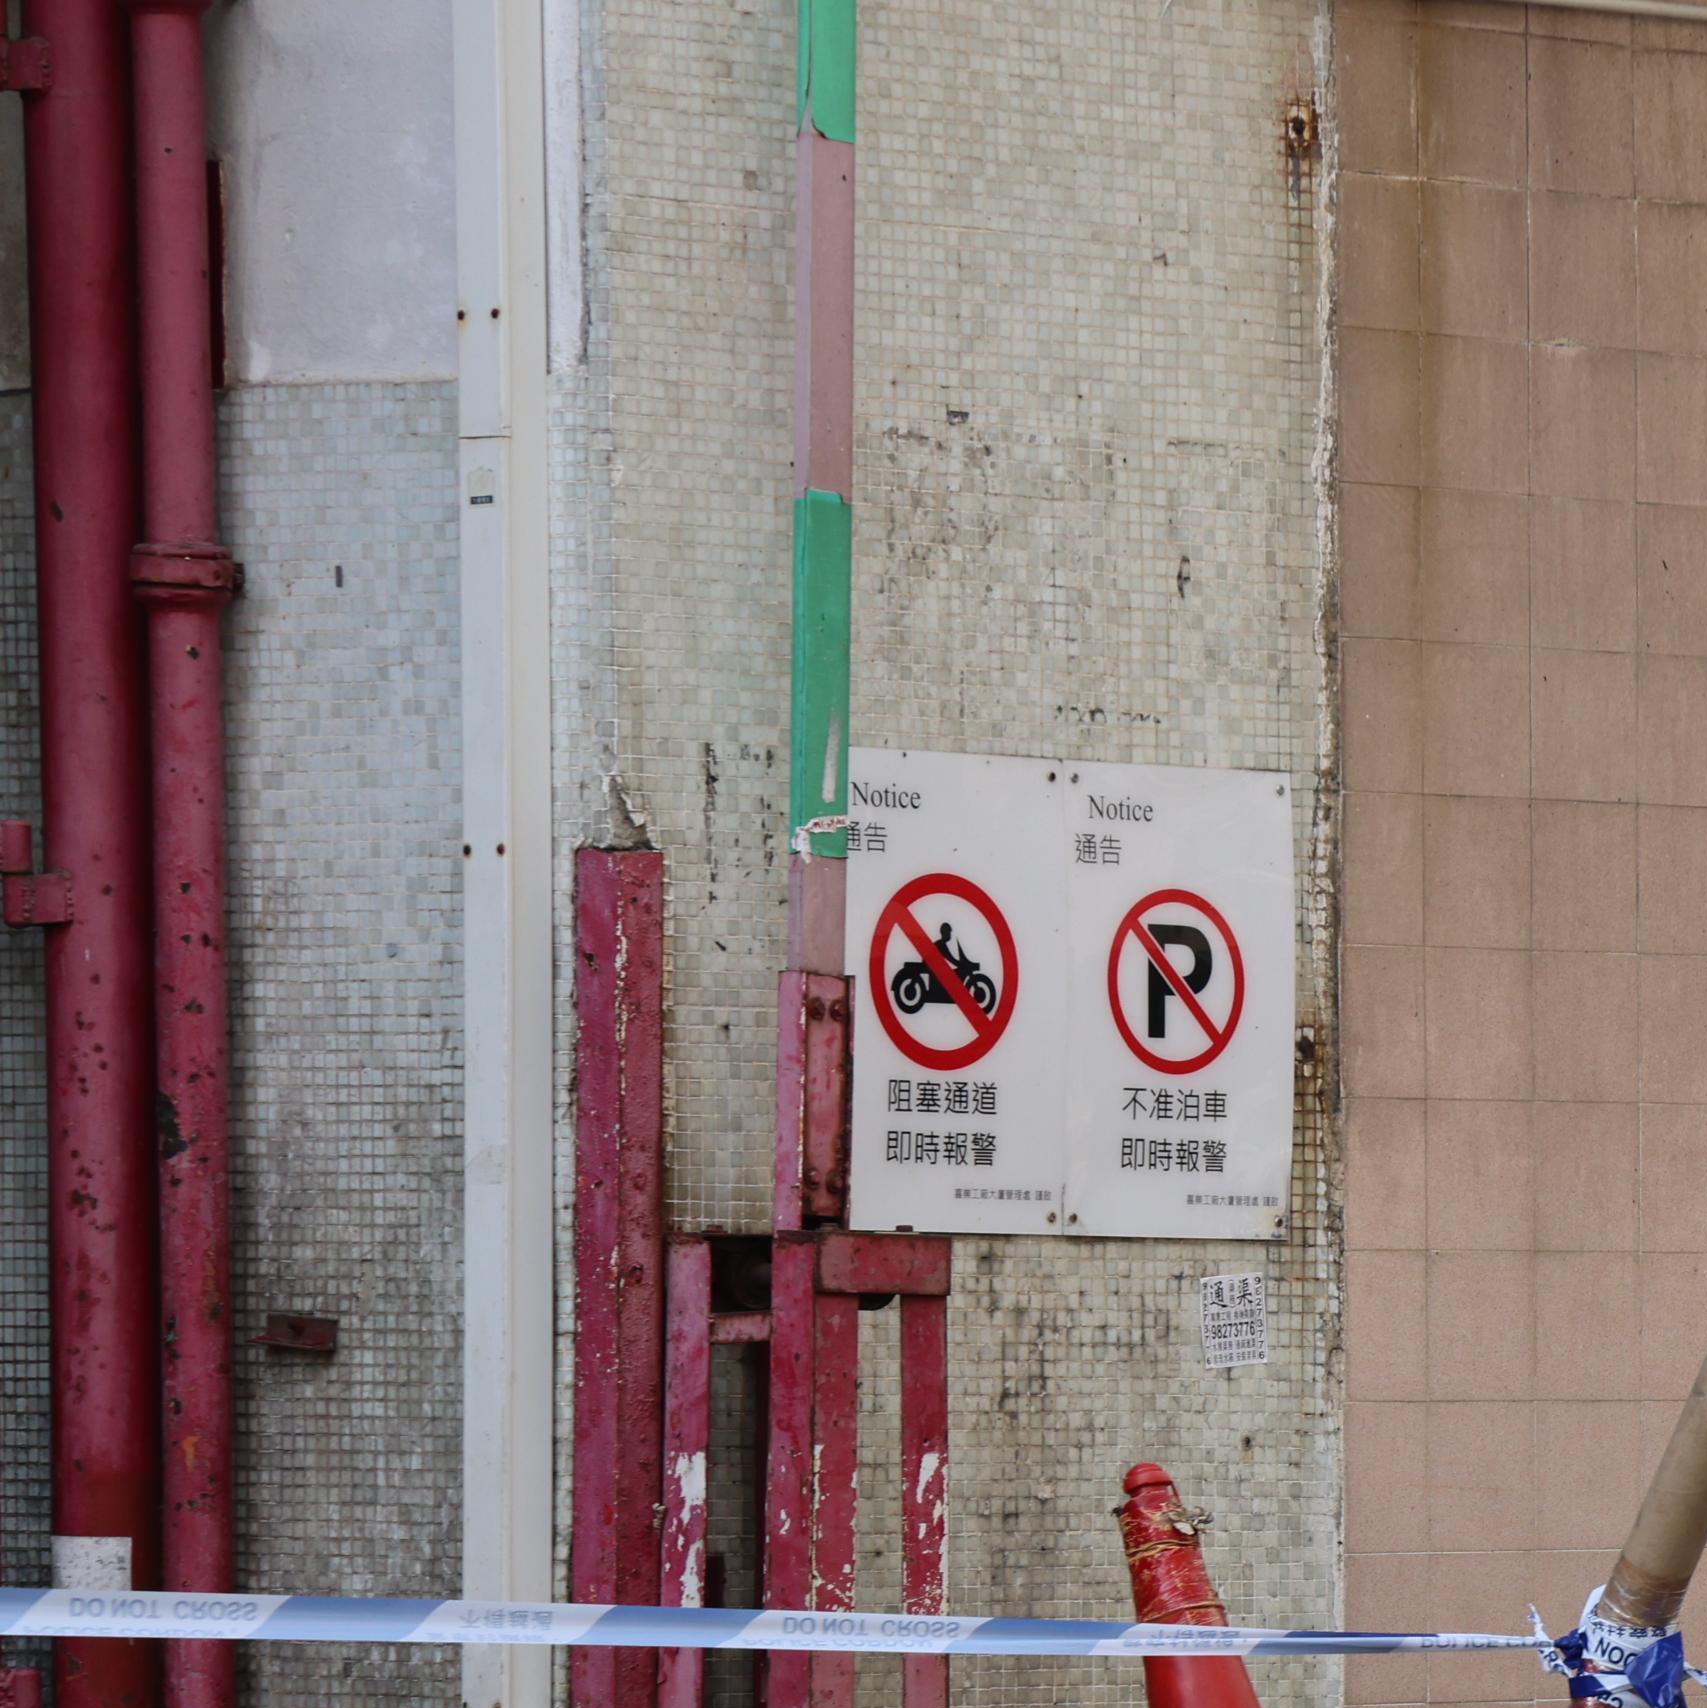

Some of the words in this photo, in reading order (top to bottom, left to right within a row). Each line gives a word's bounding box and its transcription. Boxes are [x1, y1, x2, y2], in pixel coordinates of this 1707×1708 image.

[851, 782, 922, 809] Notice
[1088, 795, 1154, 822] Notice
[1075, 833, 1122, 865] 通告
[887, 1079, 998, 1116] 阻塞通道
[1122, 1087, 1229, 1122] 不准泊車
[885, 1130, 997, 1167] 即時報警
[1120, 1137, 1228, 1173] 即時報警
